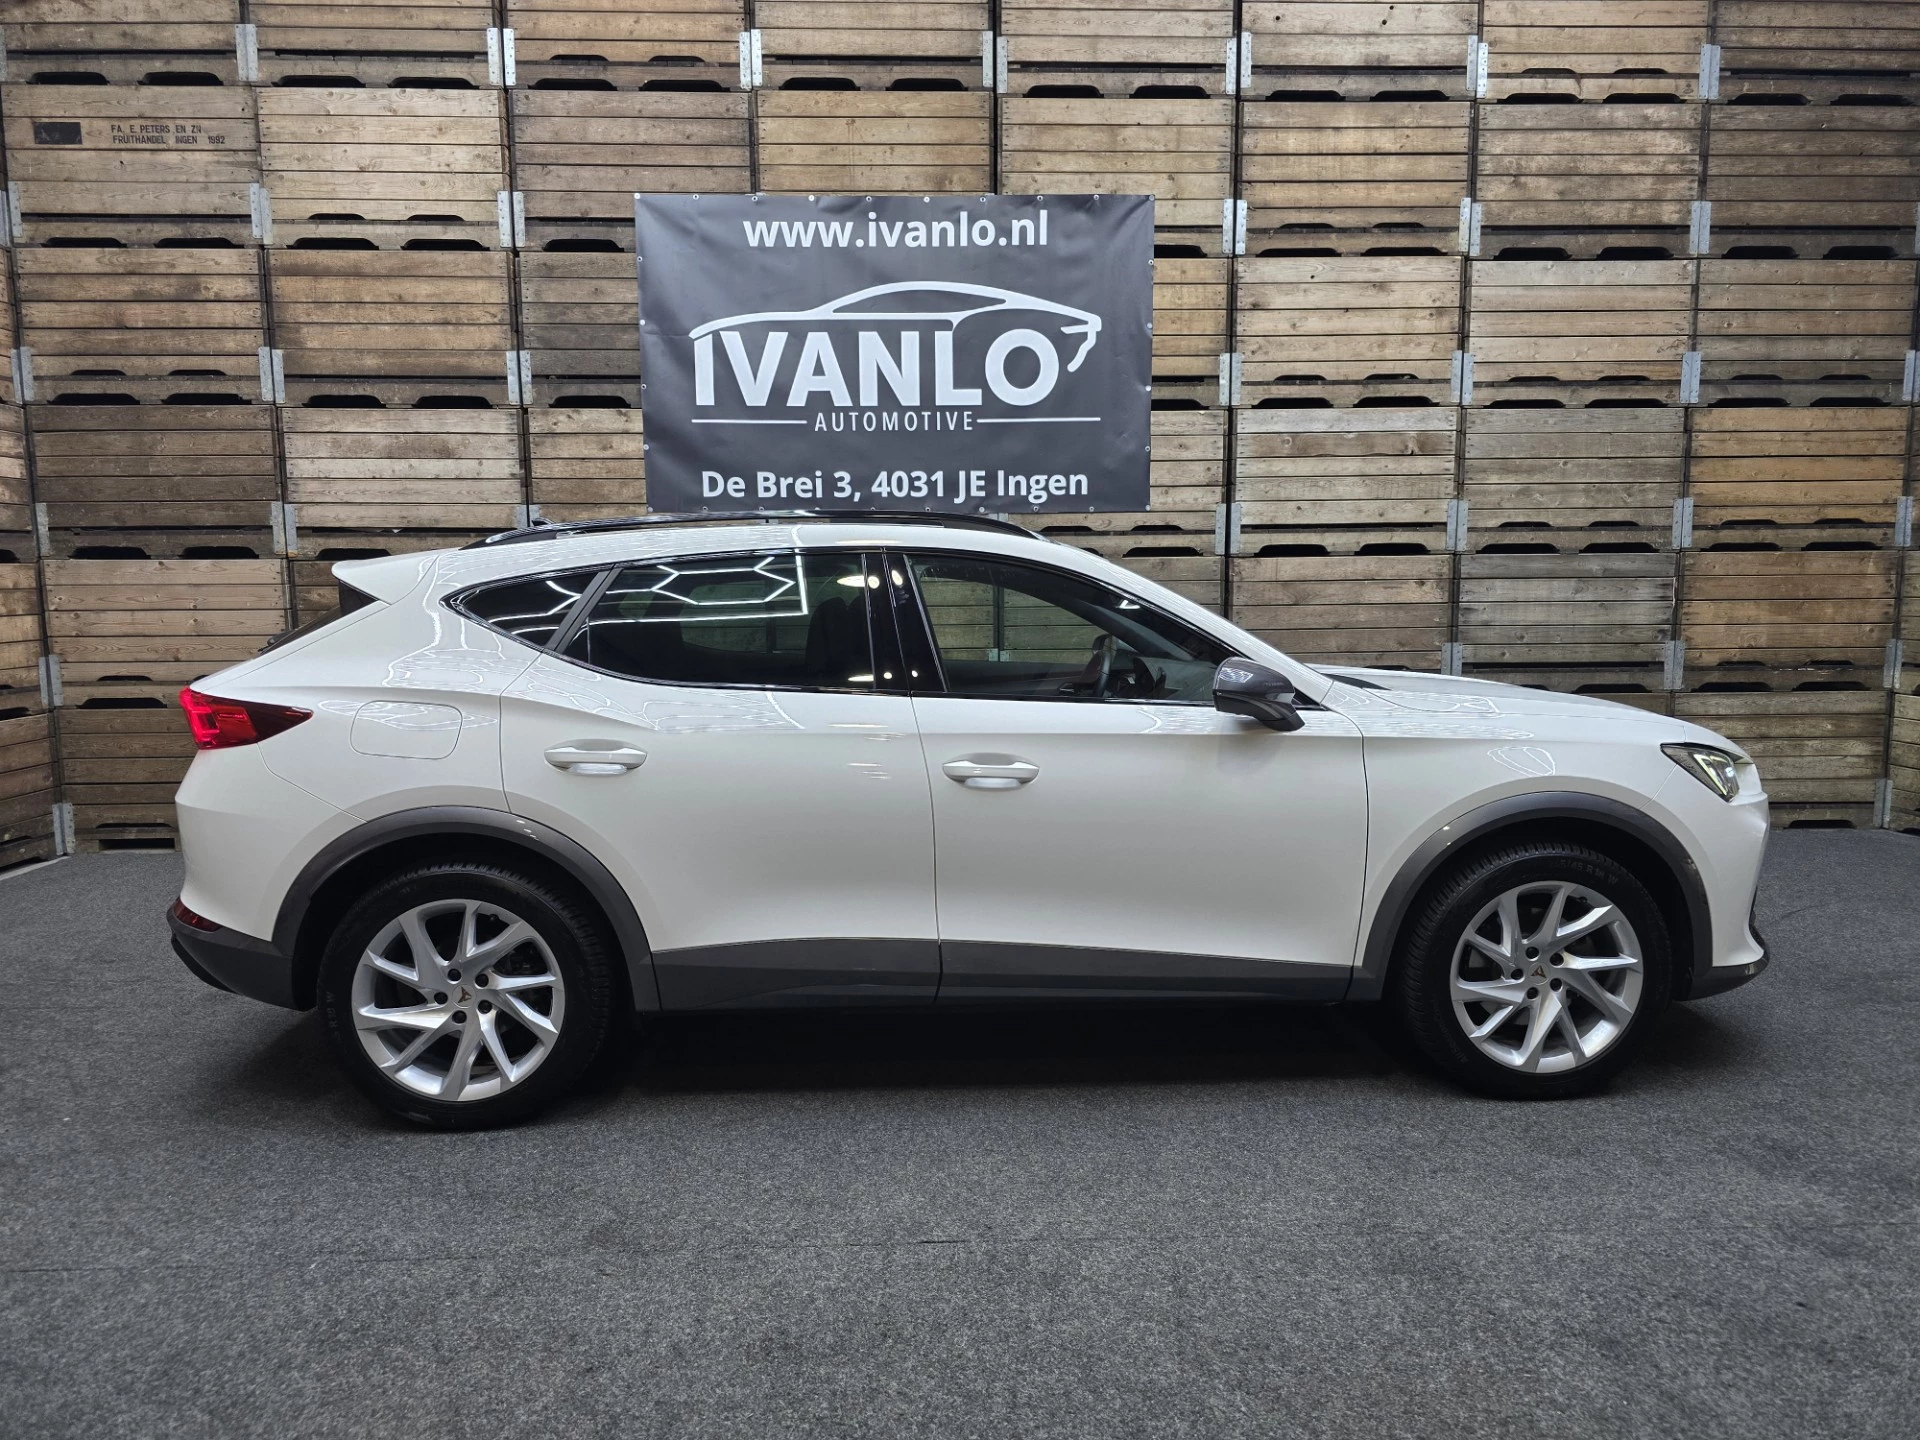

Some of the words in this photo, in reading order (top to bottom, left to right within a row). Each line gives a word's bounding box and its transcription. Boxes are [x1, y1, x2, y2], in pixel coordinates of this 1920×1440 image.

[112, 135, 166, 145] FRUITHANDEL
[175, 135, 198, 145] INGEN
[207, 135, 226, 145] 1992
[140, 124, 171, 134] PETERS
[175, 124, 186, 134] EN
[743, 210, 1048, 248] www.ivanlo.nl
[693, 329, 1060, 406] IVANLO
[814, 411, 974, 432] AUTOMOTIVE
[702, 470, 746, 498] De
[756, 470, 823, 498] Brei
[834, 470, 861, 502] 3,
[871, 470, 944, 498] 4031
[953, 470, 986, 504] JE
[997, 469, 1088, 504] Ingen
